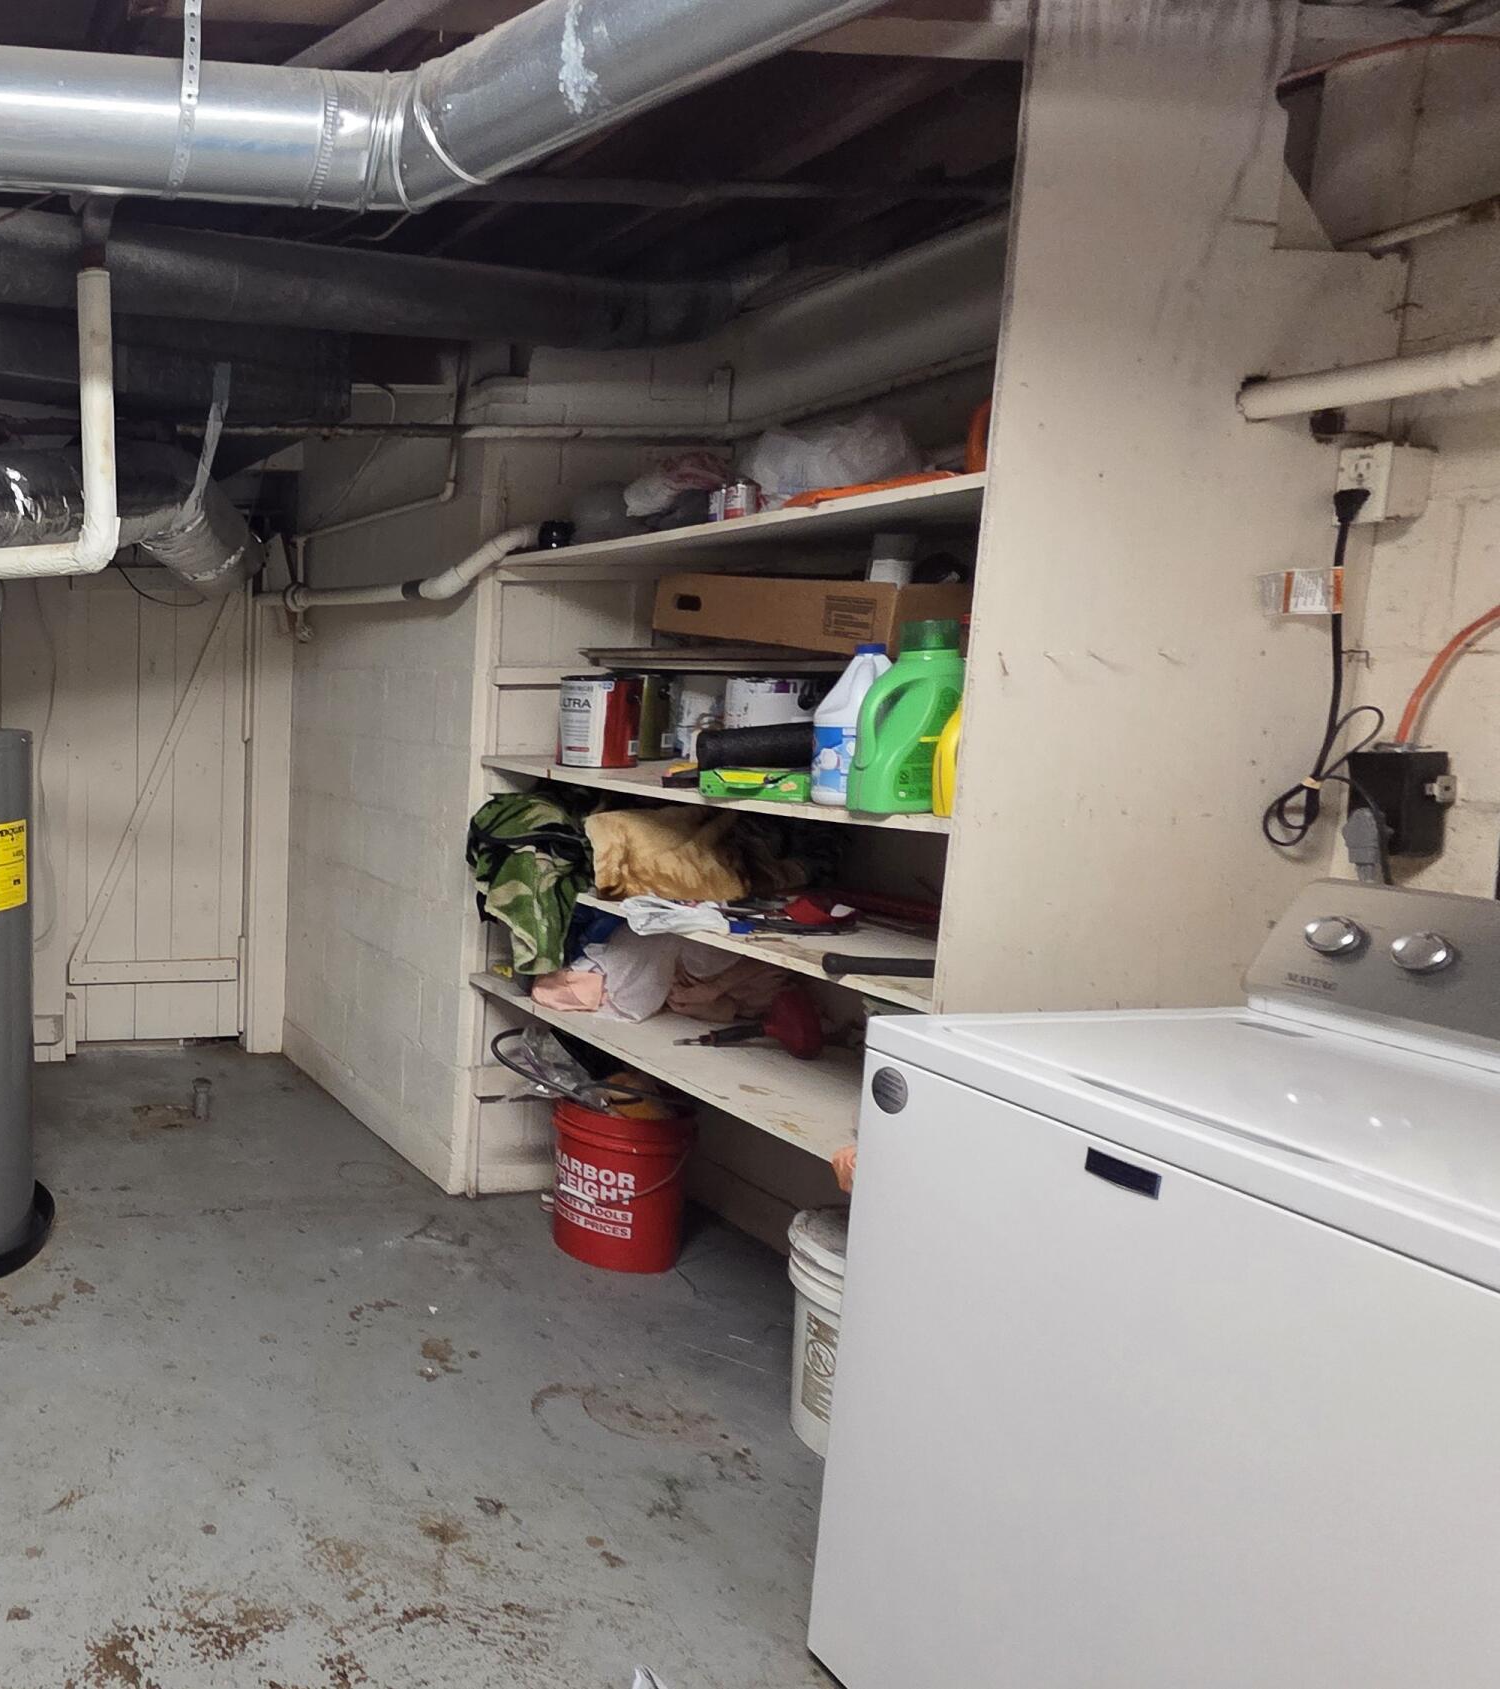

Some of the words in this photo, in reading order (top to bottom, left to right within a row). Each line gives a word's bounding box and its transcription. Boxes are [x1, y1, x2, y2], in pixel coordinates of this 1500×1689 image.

[560, 697, 592, 709] LTRA
[588, 1204, 630, 1222] TOOLS
[583, 1219, 629, 1237] PRICES
